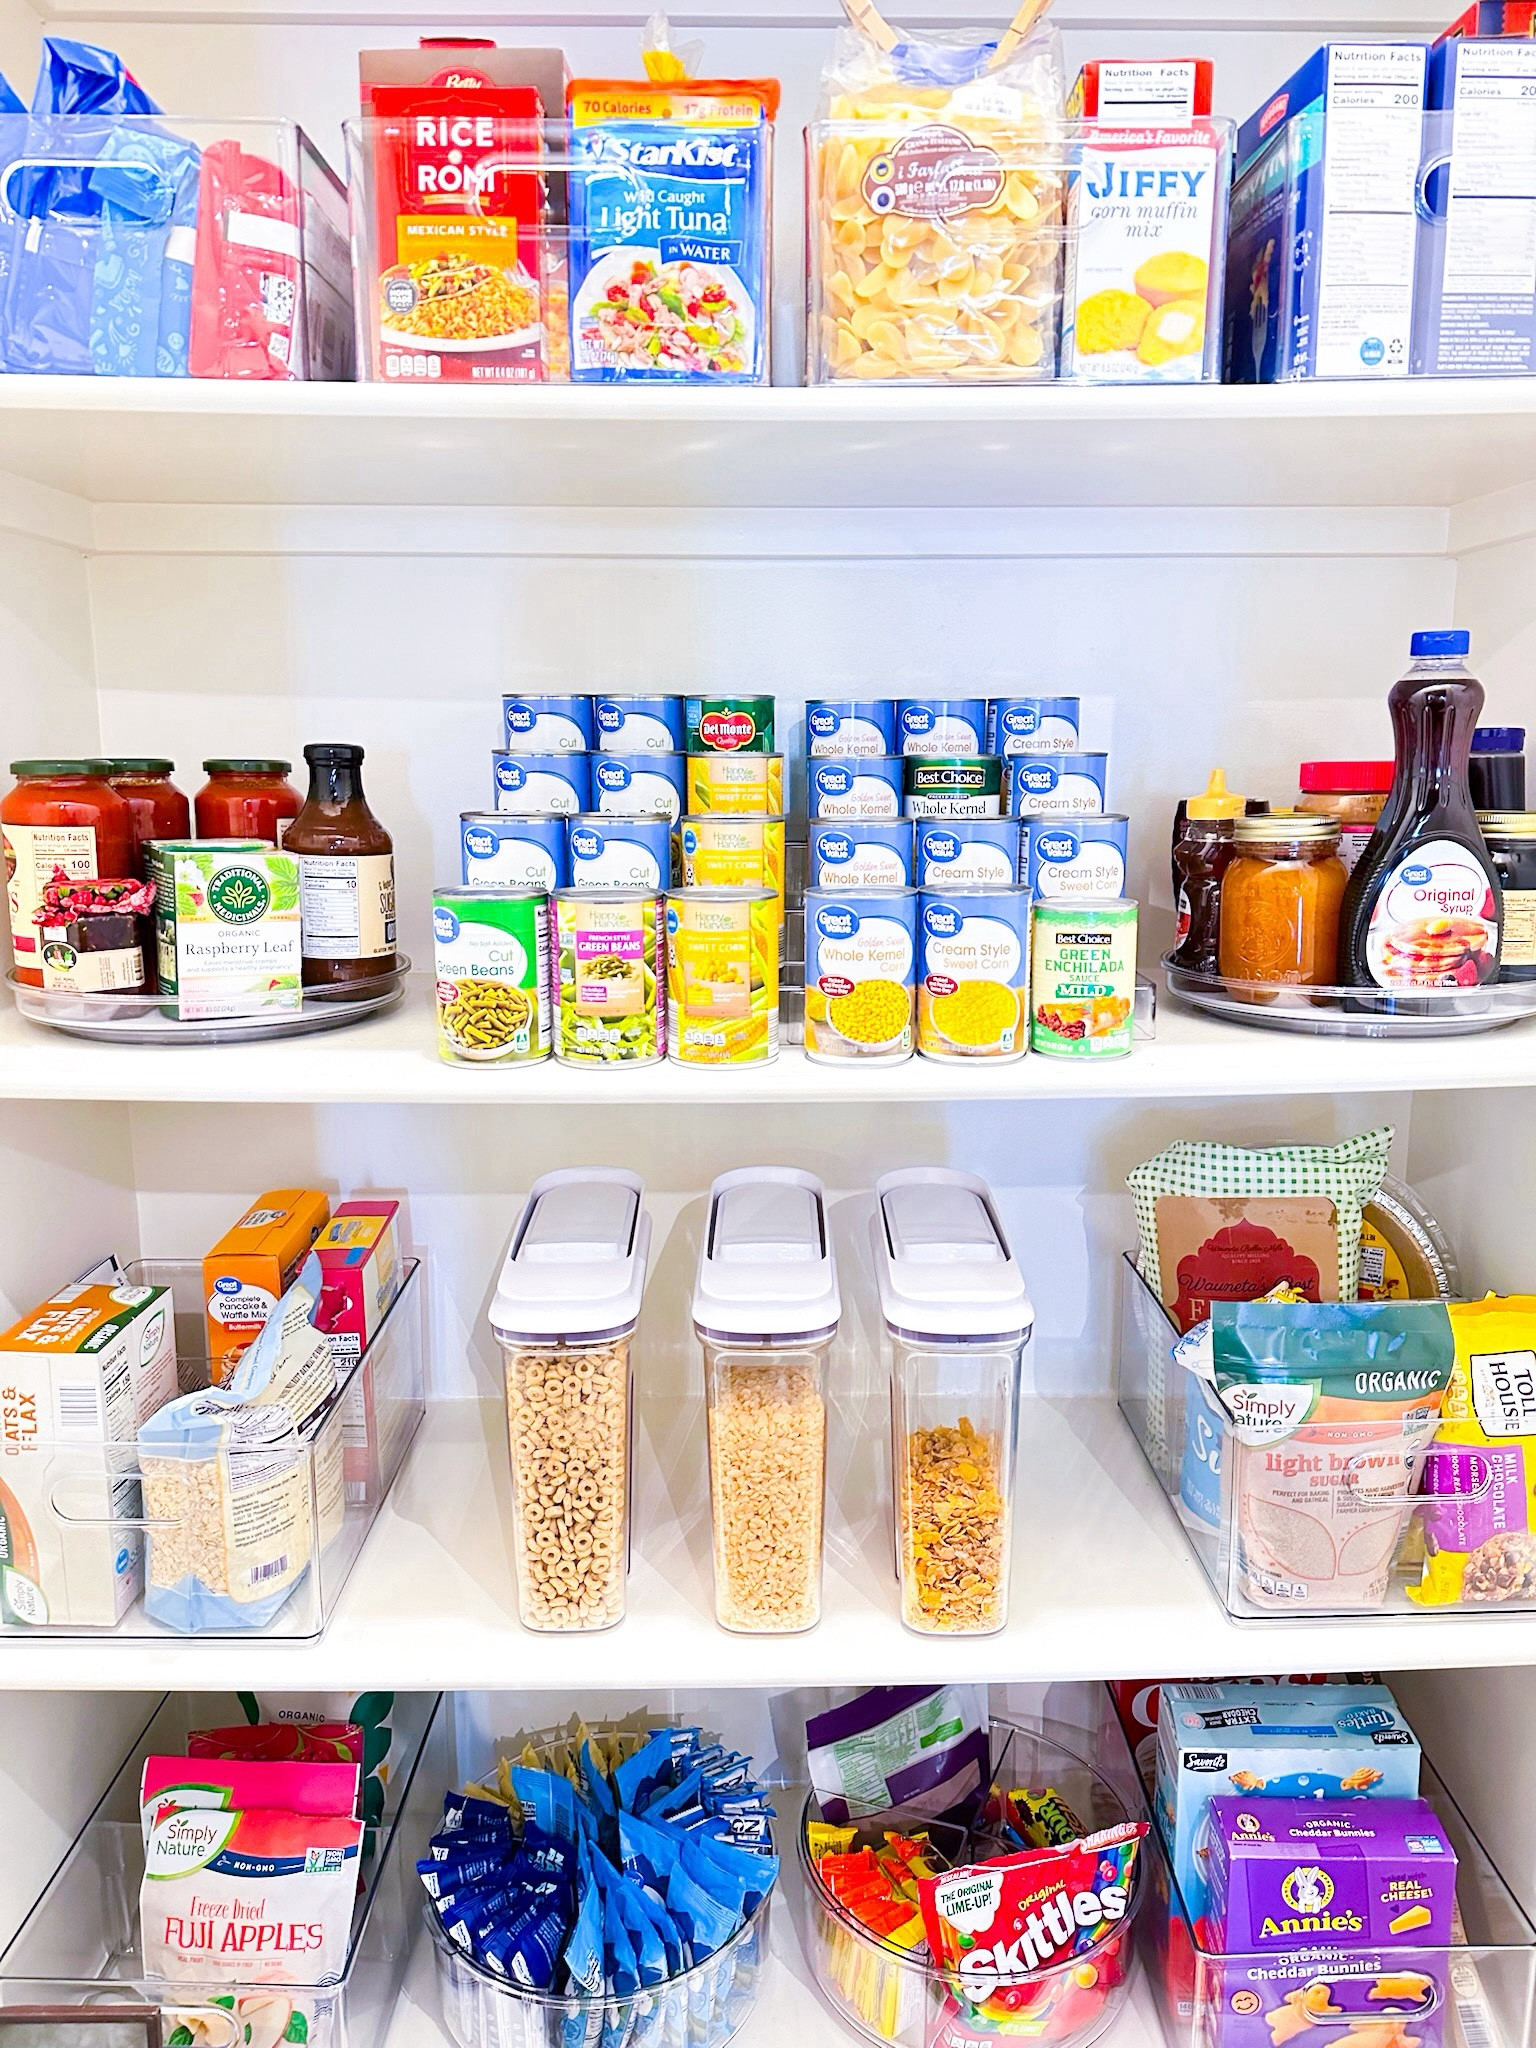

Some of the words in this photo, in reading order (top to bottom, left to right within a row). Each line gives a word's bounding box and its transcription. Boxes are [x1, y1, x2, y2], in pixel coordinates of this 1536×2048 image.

[1334, 52, 1385, 61] Nutrition
[1391, 52, 1421, 62] Facts
[1463, 48, 1514, 57] Nutrition
[1460, 88, 1501, 96] Calories
[1333, 96, 1374, 104] Calories
[1394, 94, 1418, 104] 200
[583, 100, 600, 113] 70
[603, 101, 651, 114] Calories
[685, 103, 706, 117] 17g
[710, 104, 753, 116] Protein
[417, 116, 494, 146] RICE
[1155, 130, 1210, 144] Favorite
[611, 138, 738, 167] StarKist
[1087, 162, 1206, 198] JIFFY
[657, 190, 705, 205] Caught
[1091, 203, 1130, 220] corn
[1138, 203, 1198, 219] muffin
[665, 206, 727, 232] Tuna
[407, 225, 465, 236] MEXICAN
[469, 225, 508, 238] STYLE
[1126, 223, 1163, 237] mix
[680, 245, 731, 261] WATER
[509, 710, 531, 722] Great
[599, 710, 621, 722] Great
[703, 723, 720, 735] Del
[722, 723, 752, 736] Monte
[559, 738, 577, 748] Cut
[646, 738, 664, 748] Cut
[907, 742, 937, 753] Whole
[941, 741, 972, 752] Kernel
[1012, 739, 1049, 750] Cream
[1052, 738, 1074, 750] Style
[498, 768, 520, 780] Great
[599, 768, 621, 780] Great
[723, 766, 748, 777] Happy
[917, 771, 940, 784] Best
[941, 771, 983, 784] Choice
[550, 798, 569, 808] Cut
[654, 798, 673, 808] Cut
[851, 793, 872, 803] Golden
[1028, 798, 1066, 809] Cream
[1071, 797, 1096, 811] Style
[823, 803, 857, 814] Whole
[860, 803, 892, 814] Kernel
[912, 801, 945, 815] Whole
[949, 800, 987, 814] Kernel
[33, 833, 65, 842] Nutrition
[68, 833, 89, 842] Facts
[714, 832, 741, 843] Happy
[718, 839, 750, 849] Harvest
[526, 866, 546, 878] Cut
[853, 862, 876, 871] Golden
[932, 866, 974, 879] Cream
[978, 866, 1004, 880] Style
[1048, 866, 1092, 879] Cream
[1096, 865, 1119, 879] Style
[212, 869, 265, 892] TRADITIONAL
[824, 872, 859, 884] Whole
[863, 871, 898, 884] Kernel
[346, 880, 357, 889] 10
[1060, 880, 1092, 891] Sweet
[1096, 879, 1118, 890] Corn
[1414, 889, 1475, 904] Original
[214, 899, 266, 922] MEDICINALS
[589, 910, 619, 921] Happy
[1442, 903, 1474, 916] Syrup
[594, 918, 632, 928] Harvest
[700, 920, 735, 929] Harvest
[218, 930, 260, 938] ORGANIC
[1056, 934, 1077, 945] Best
[1078, 933, 1111, 945] Choice
[186, 942, 260, 957] Raspberry
[264, 940, 294, 953] Leaf
[579, 942, 609, 952] GREEN
[611, 941, 641, 951] BEANS
[858, 937, 883, 948] Golden
[933, 942, 975, 955] Cream
[979, 943, 1011, 956] Style
[824, 949, 865, 961] Whole
[868, 948, 906, 961] Kernel
[1059, 948, 1111, 961] GREEN
[880, 961, 905, 973] Corn
[943, 957, 979, 969] Sweet
[983, 957, 1009, 969] Corn
[1046, 960, 1124, 973] ENCHILADA
[471, 964, 514, 976] Beans
[1057, 985, 1107, 996] MILD
[1178, 1274, 1268, 1293] Wauneta's
[219, 1302, 259, 1311] Pancake
[225, 1296, 261, 1304] Complete
[221, 1311, 249, 1319] Waffle
[251, 1311, 268, 1319] Mix
[228, 1323, 262, 1331] Buttermilk
[339, 1334, 359, 1342] Facts
[1355, 1369, 1442, 1395] ORGANIC
[1489, 1361, 1520, 1431] HOUSE
[1233, 1393, 1296, 1418] Simply
[19, 1394, 38, 1451] FLAX
[4, 1408, 20, 1456] OATS
[1266, 1453, 1322, 1477] light
[1329, 1452, 1401, 1470] brown
[1504, 1453, 1519, 1485] MILK
[1310, 1473, 1359, 1487] SUGAR
[1491, 1454, 1507, 1530] CHOCOLATE
[278, 1710, 325, 1723] ORGANIC
[1221, 1708, 1257, 1719] CHEDDAR
[1347, 1707, 1376, 1718] BAKED
[1225, 1715, 1257, 1726] EXTRA
[1338, 1710, 1395, 1729] Turtles
[1374, 1731, 1410, 1744] Savoritz
[1186, 1755, 1227, 1770] Savoritz
[1305, 1820, 1351, 1829] ORGANIC
[167, 1824, 217, 1844] Simply
[1231, 1831, 1276, 1842] Annie's
[1289, 1828, 1332, 1837] Cheddar
[1334, 1829, 1376, 1837] Bunnies
[157, 1841, 205, 1857] Nature
[233, 1861, 275, 1871] NON-GMO
[941, 1890, 956, 1903] THE
[957, 1880, 993, 1897] ORIGINAL
[1389, 1881, 1421, 1891] REAL
[1380, 1888, 1434, 1903] CHEESE!
[190, 1896, 229, 1918] Freeze
[233, 1898, 265, 1920] Dried
[946, 1896, 992, 1917] LIME-UP!
[1259, 1909, 1363, 1939] Annie's
[165, 1917, 214, 1949] FUJI
[221, 1922, 323, 1953] APPLES
[959, 1886, 1128, 2003] Skittles
[1247, 1962, 1314, 1981] Cheddar
[1318, 1959, 1382, 1975] Bunnies
